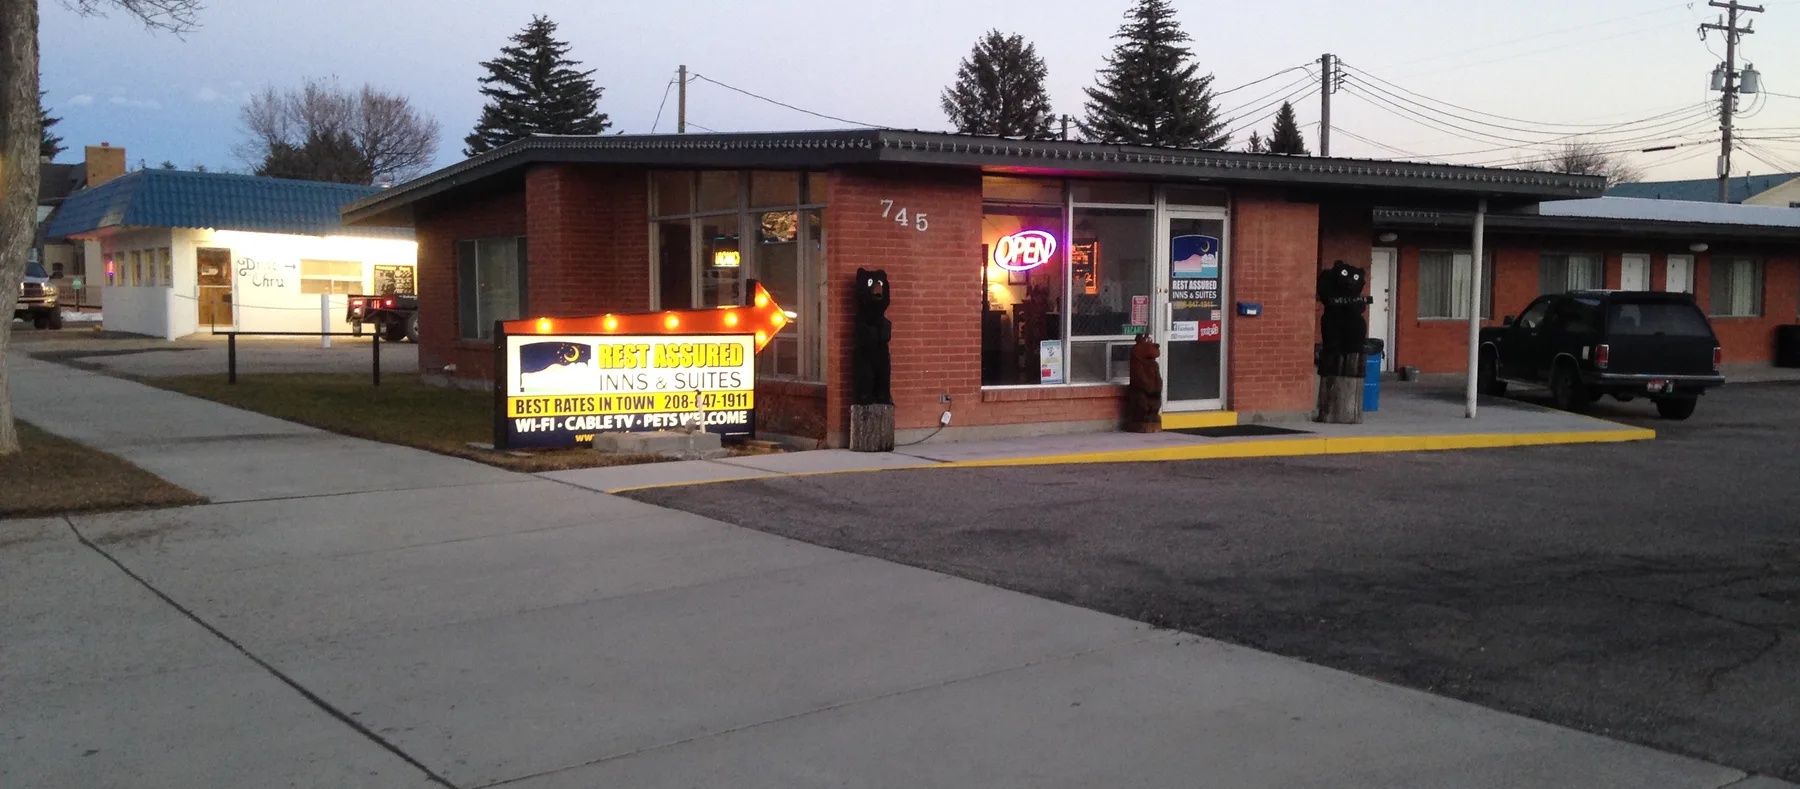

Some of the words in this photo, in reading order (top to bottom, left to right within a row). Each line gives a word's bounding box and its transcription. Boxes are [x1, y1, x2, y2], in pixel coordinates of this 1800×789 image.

[880, 199, 929, 232] 745
[995, 236, 1052, 264] OPEN
[1172, 280, 1188, 290] REST
[1189, 280, 1217, 290] ASSURED
[1172, 291, 1188, 299] INNS
[1195, 291, 1217, 299] SUITES
[598, 343, 650, 370] REST
[653, 342, 744, 369] ASSURED
[600, 373, 648, 391] INNS
[656, 376, 668, 390] &
[675, 371, 742, 390] SUITES
[516, 398, 550, 415] BEST
[554, 396, 595, 413] RATES
[599, 396, 612, 411] IN
[616, 395, 654, 411] TOWN
[515, 417, 555, 432] WI-FI
[564, 415, 613, 430] CABLE
[614, 414, 635, 429] TV
[643, 412, 679, 427] PETS
[679, 410, 748, 426] WELCOME
